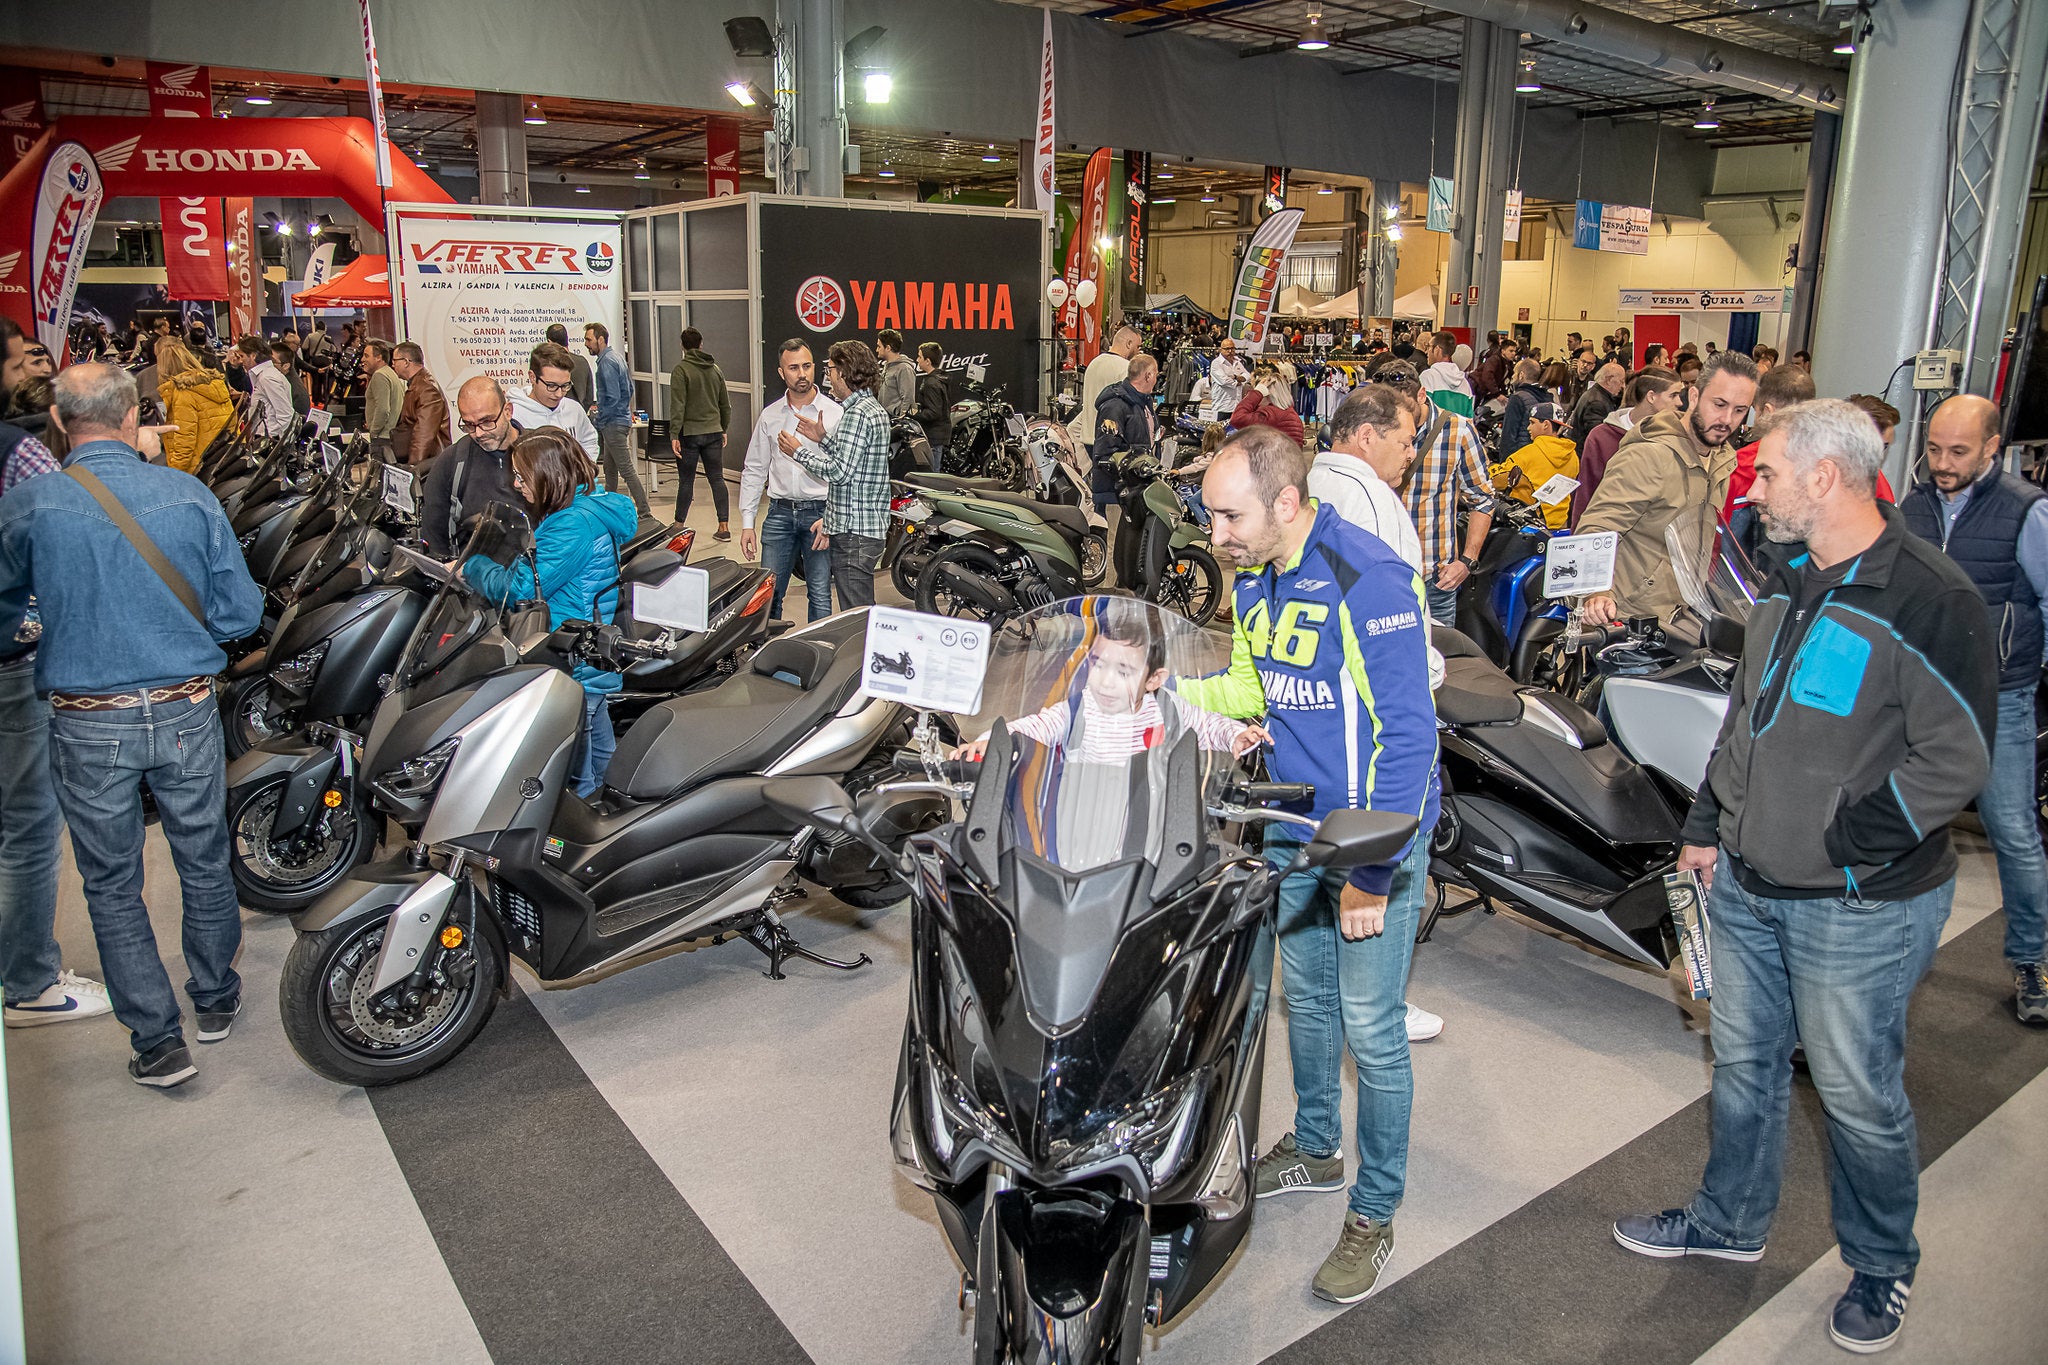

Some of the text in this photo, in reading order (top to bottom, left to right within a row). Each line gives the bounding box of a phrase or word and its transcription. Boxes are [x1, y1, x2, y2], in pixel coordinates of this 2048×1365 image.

[154, 87, 206, 98] HONDA
[142, 148, 320, 172] HONDA
[1601, 221, 1625, 231] VESPA
[237, 207, 253, 309] HONDA
[457, 263, 499, 275] YAMAHA
[421, 282, 609, 291] ALZIRA GANDIA VALENCIA BENIDORM
[1231, 246, 1285, 343] SAICA
[341, 299, 391, 307] HONDA
[849, 280, 1015, 330] YAMAHA
[1652, 297, 1690, 305] VESPA
[460, 307, 490, 315] ALZIRA
[493, 308, 511, 316] Avda.
[513, 308, 535, 316] Joanot
[536, 308, 567, 317] Martorell,
[555, 316, 585, 324] (Valencia)
[473, 328, 506, 336] GANDIA
[509, 328, 527, 336] Avda.
[528, 328, 539, 336] del
[509, 336, 528, 344] 46701
[460, 348, 500, 357] VALENCIA
[939, 352, 989, 371] Heart
[484, 369, 524, 377] VALENCIA
[1378, 611, 1417, 630] YAMAHA
[1242, 597, 1330, 670] 46
[1368, 627, 1397, 637] FACTORY
[963, 637, 976, 645] E10
[1277, 703, 1336, 711] RACING
[1691, 923, 1712, 989] PROTAGONISTA
[1694, 981, 1704, 992] La
